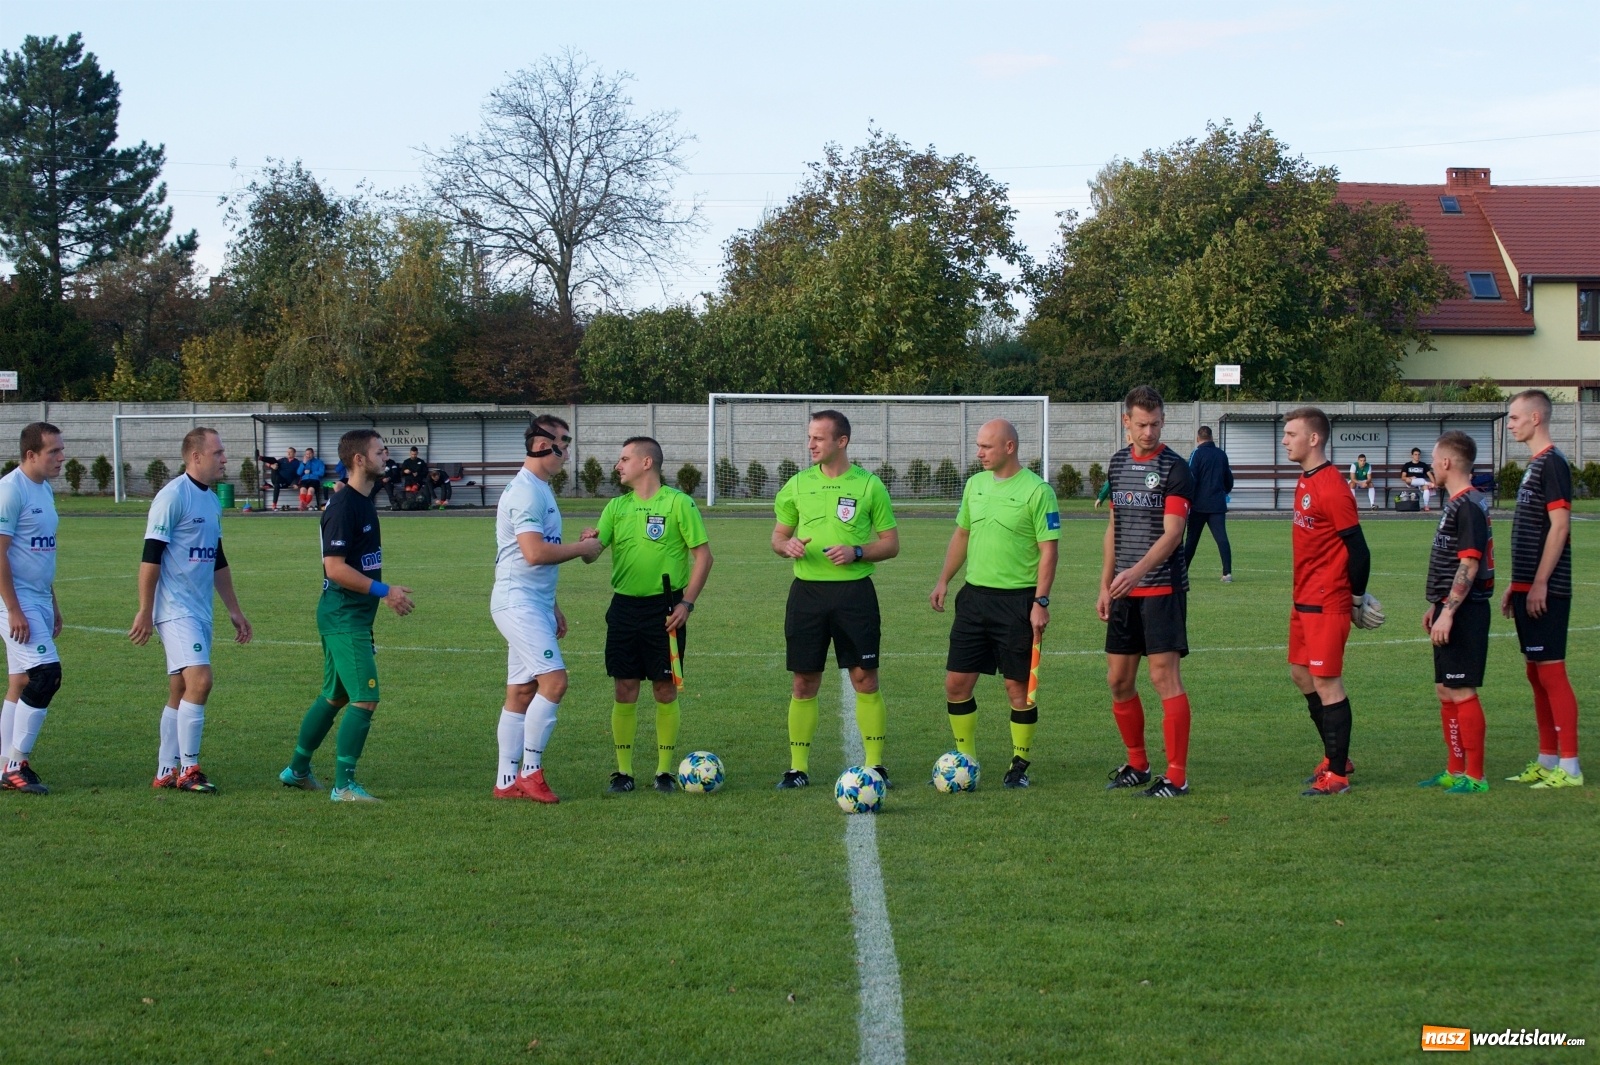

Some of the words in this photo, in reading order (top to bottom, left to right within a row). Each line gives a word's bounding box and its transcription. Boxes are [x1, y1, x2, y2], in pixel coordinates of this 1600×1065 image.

[392, 428, 410, 436] LKS
[1340, 430, 1380, 441] GOŚCIE
[381, 434, 426, 445] WORKÓW
[1112, 491, 1163, 507] PROSAT
